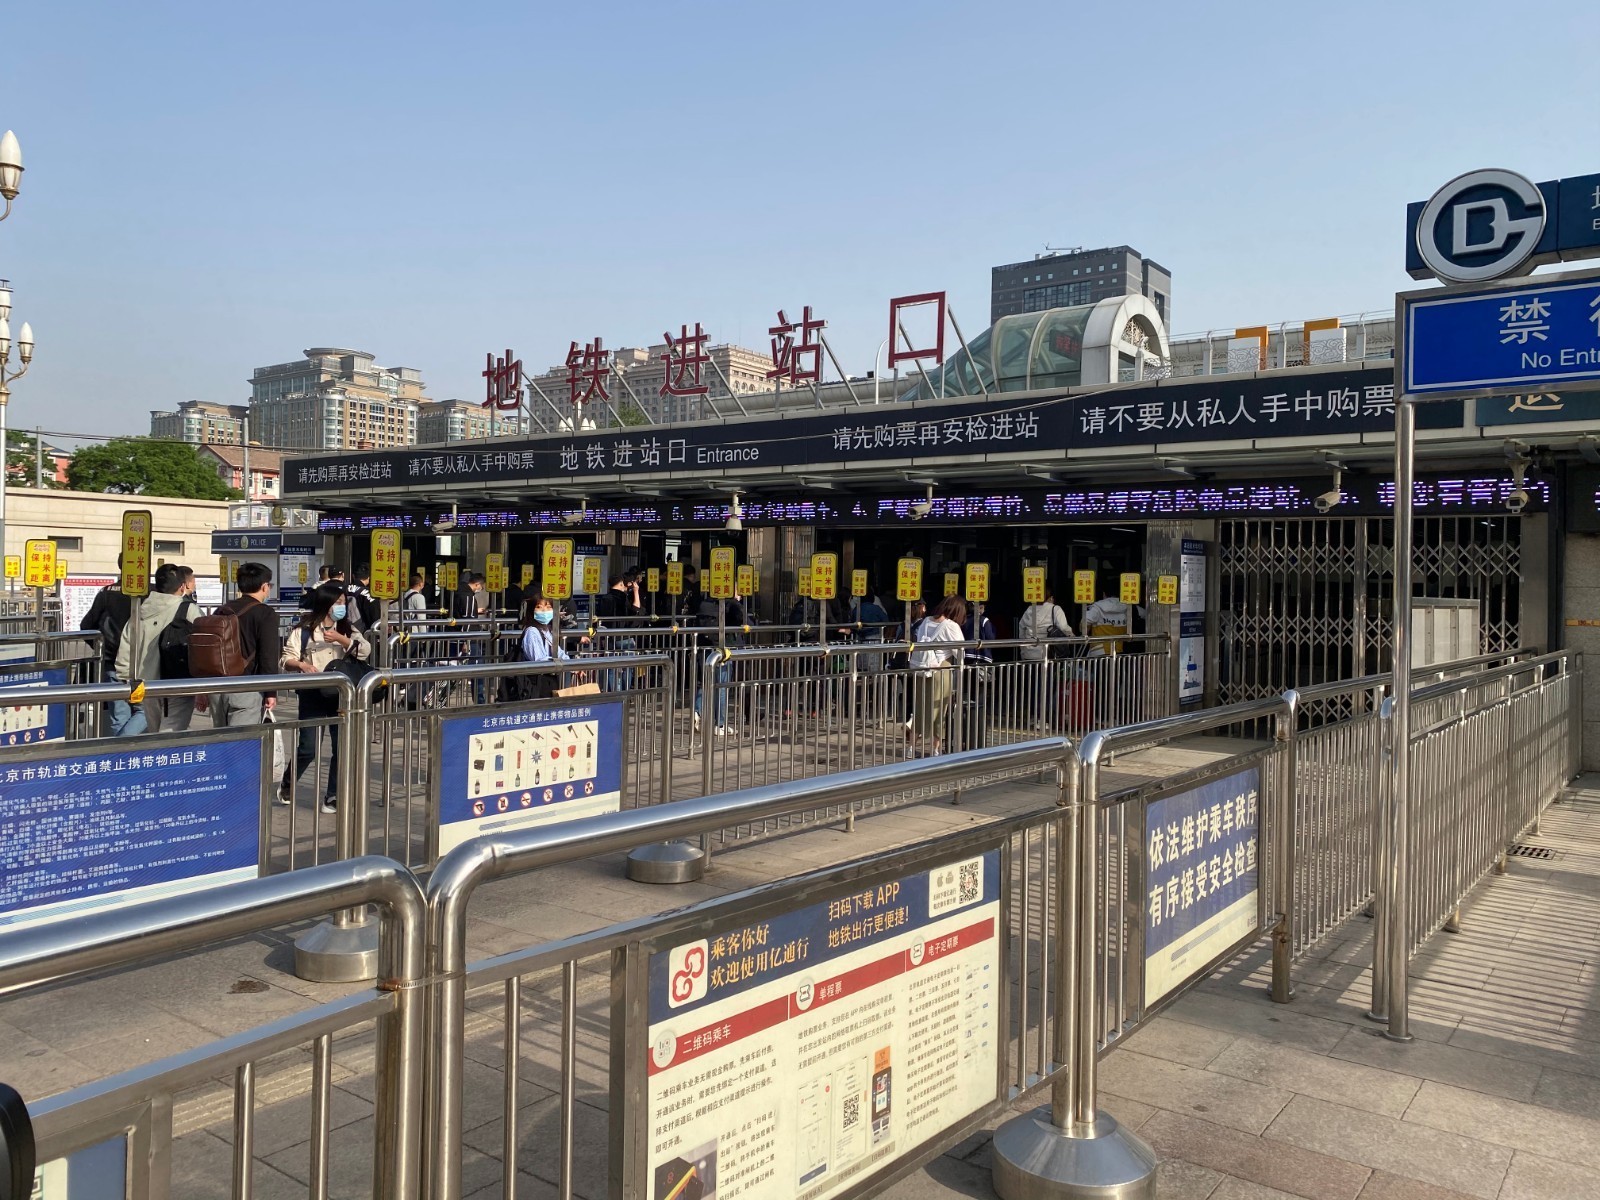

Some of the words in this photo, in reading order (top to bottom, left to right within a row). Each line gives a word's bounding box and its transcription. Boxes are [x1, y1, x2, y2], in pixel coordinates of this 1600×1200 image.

[482, 291, 946, 410] 地铁进站口
[1521, 352, 1551, 369] No
[1080, 384, 1395, 434] 请不要从私人手中购票
[832, 411, 1040, 450] 请先购票再安检进站
[559, 437, 686, 471] 地铁进站口
[697, 447, 759, 464] Entrance
[408, 449, 535, 477] 请不要从私人手中购票
[298, 461, 392, 484] 请先购票再安检进站
[127, 537, 145, 552] 保持
[32, 553, 51, 562] 保持
[126, 556, 144, 570] 一米
[376, 549, 395, 562] 保持
[548, 556, 567, 568] 保持
[31, 564, 51, 572] 一米
[375, 565, 395, 578] 一米
[714, 562, 731, 572] 保持
[816, 566, 832, 575] 保持
[31, 574, 51, 582] 距离
[126, 574, 144, 590] 距离
[547, 570, 567, 581] 一米
[714, 573, 730, 583] 一米
[815, 577, 832, 585] 一米
[374, 580, 395, 594] 距离
[546, 583, 567, 594] 距离
[713, 586, 730, 594] 距离
[815, 587, 832, 595] 距离
[0, 750, 207, 783] 京市轨道交通禁止携带物品目录
[1149, 789, 1258, 873] 依法维护乘车秩序
[1149, 836, 1257, 927] 有序接受安全检查
[829, 890, 874, 922] 扫码下载
[876, 882, 900, 907] APP
[710, 923, 769, 961] 乘客你好
[710, 937, 809, 990] 欢迎使用亿通行
[819, 980, 842, 1001] 单程票
[683, 1023, 731, 1054] 二维码乘车
